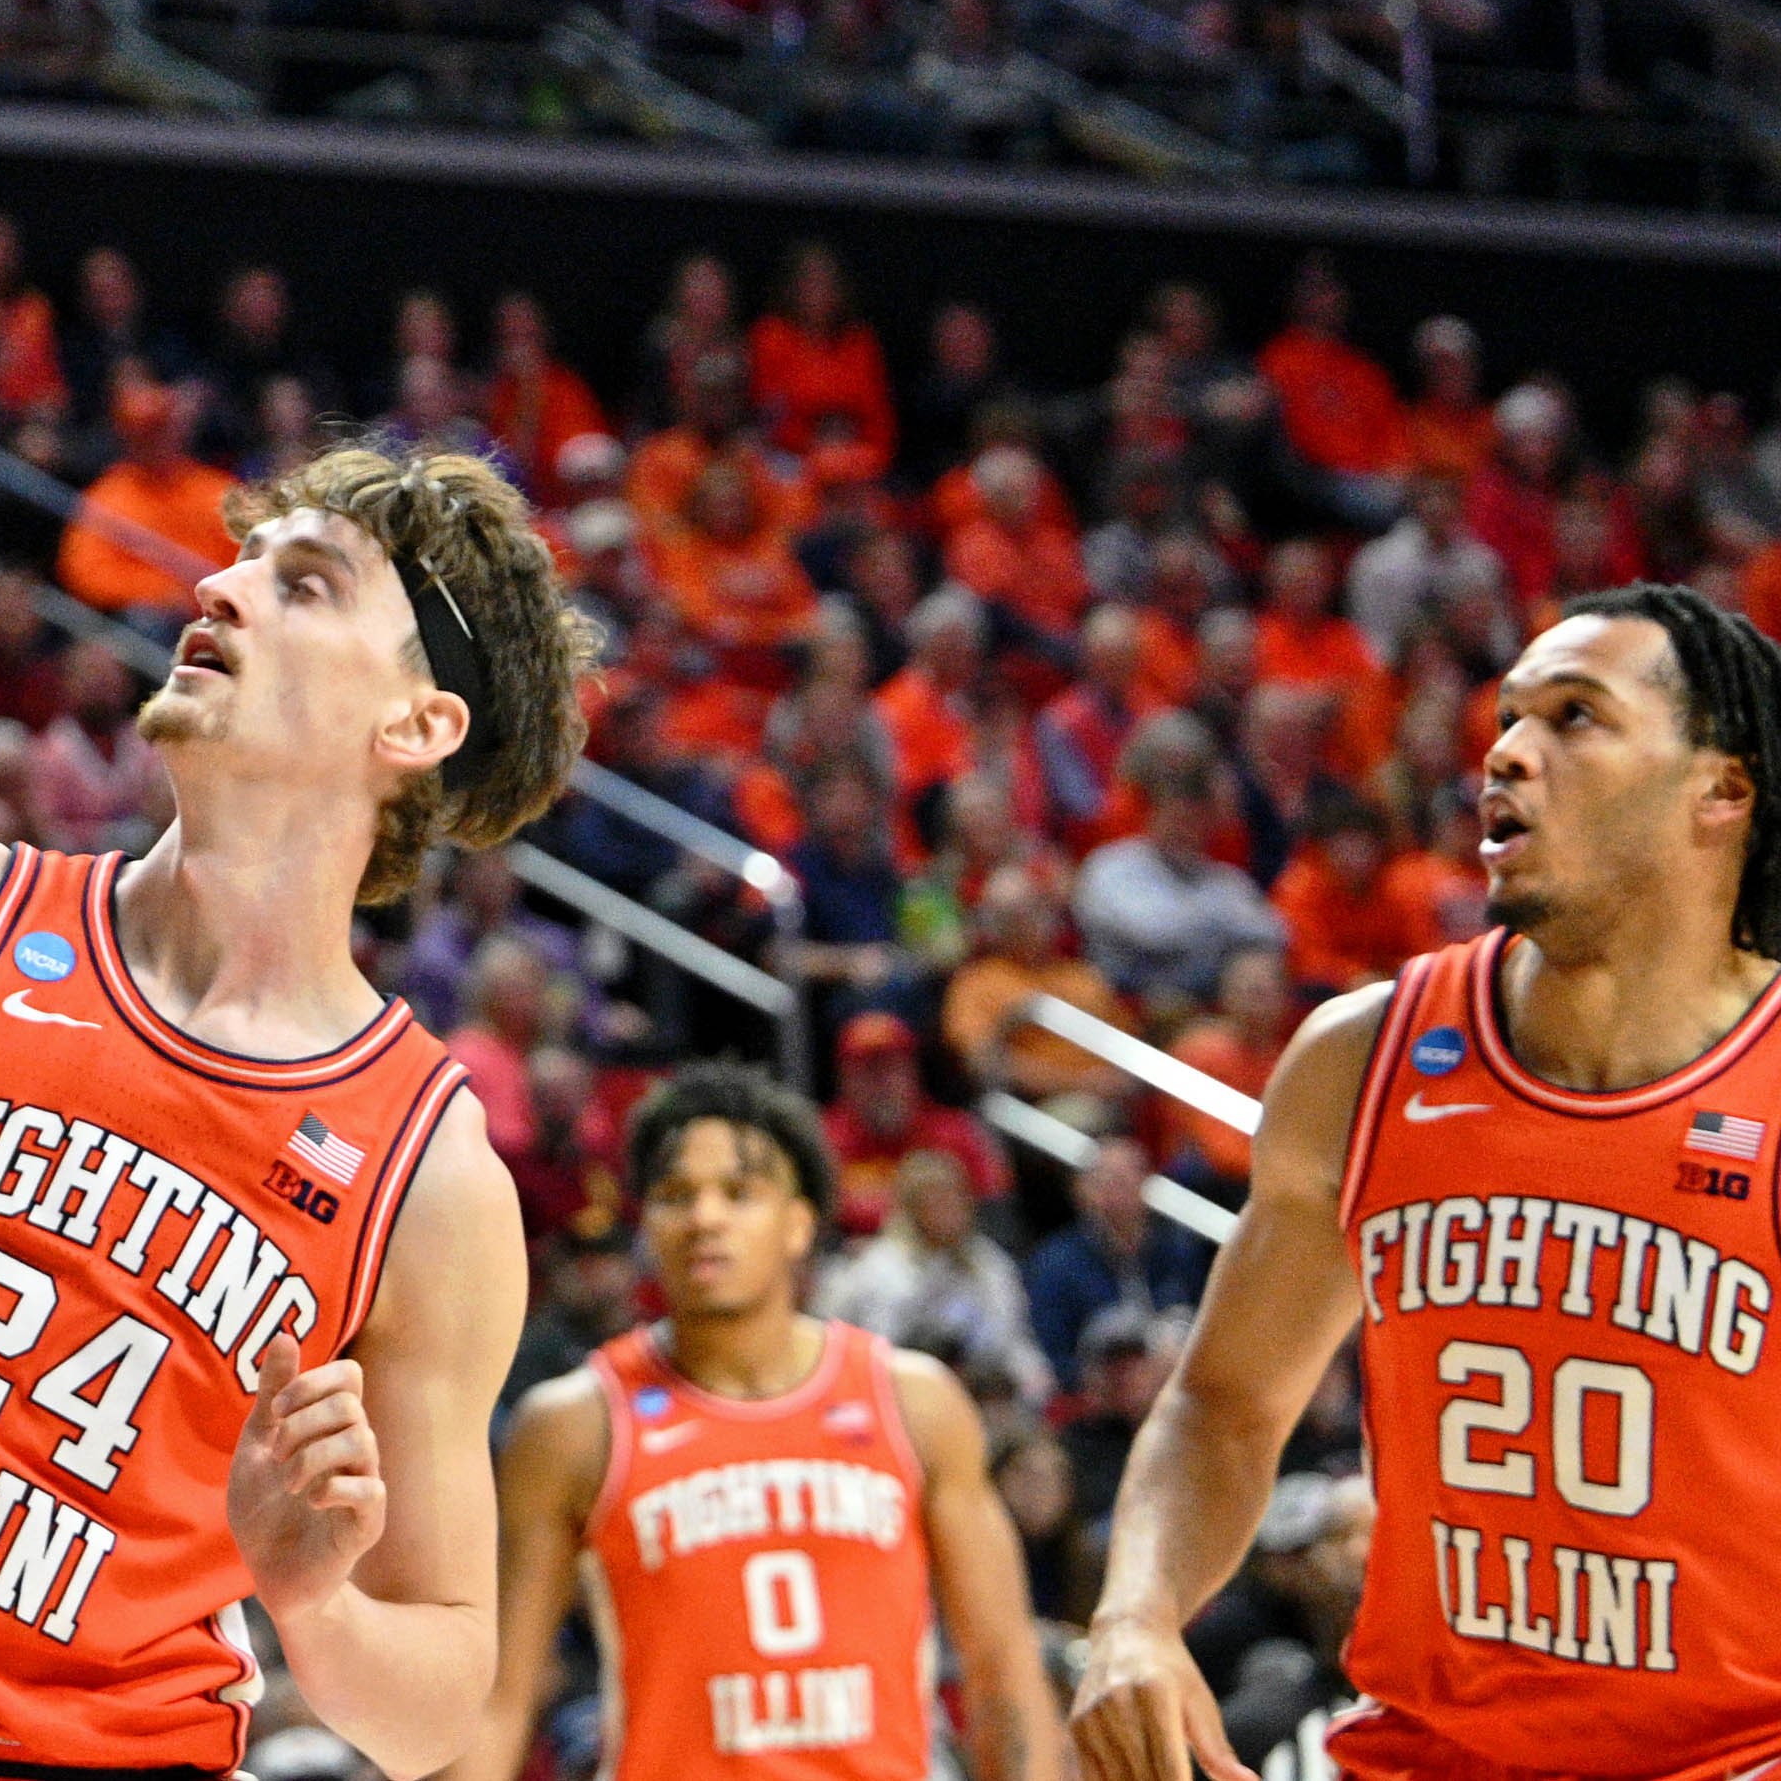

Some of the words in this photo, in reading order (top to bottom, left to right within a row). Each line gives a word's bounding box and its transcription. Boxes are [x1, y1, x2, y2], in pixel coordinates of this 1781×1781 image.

[1361, 1195, 1772, 1377] FIGHTING
[1438, 1339, 1654, 1518] 20
[630, 1458, 907, 1570] FIGHTING
[742, 1549, 825, 1657] 0
